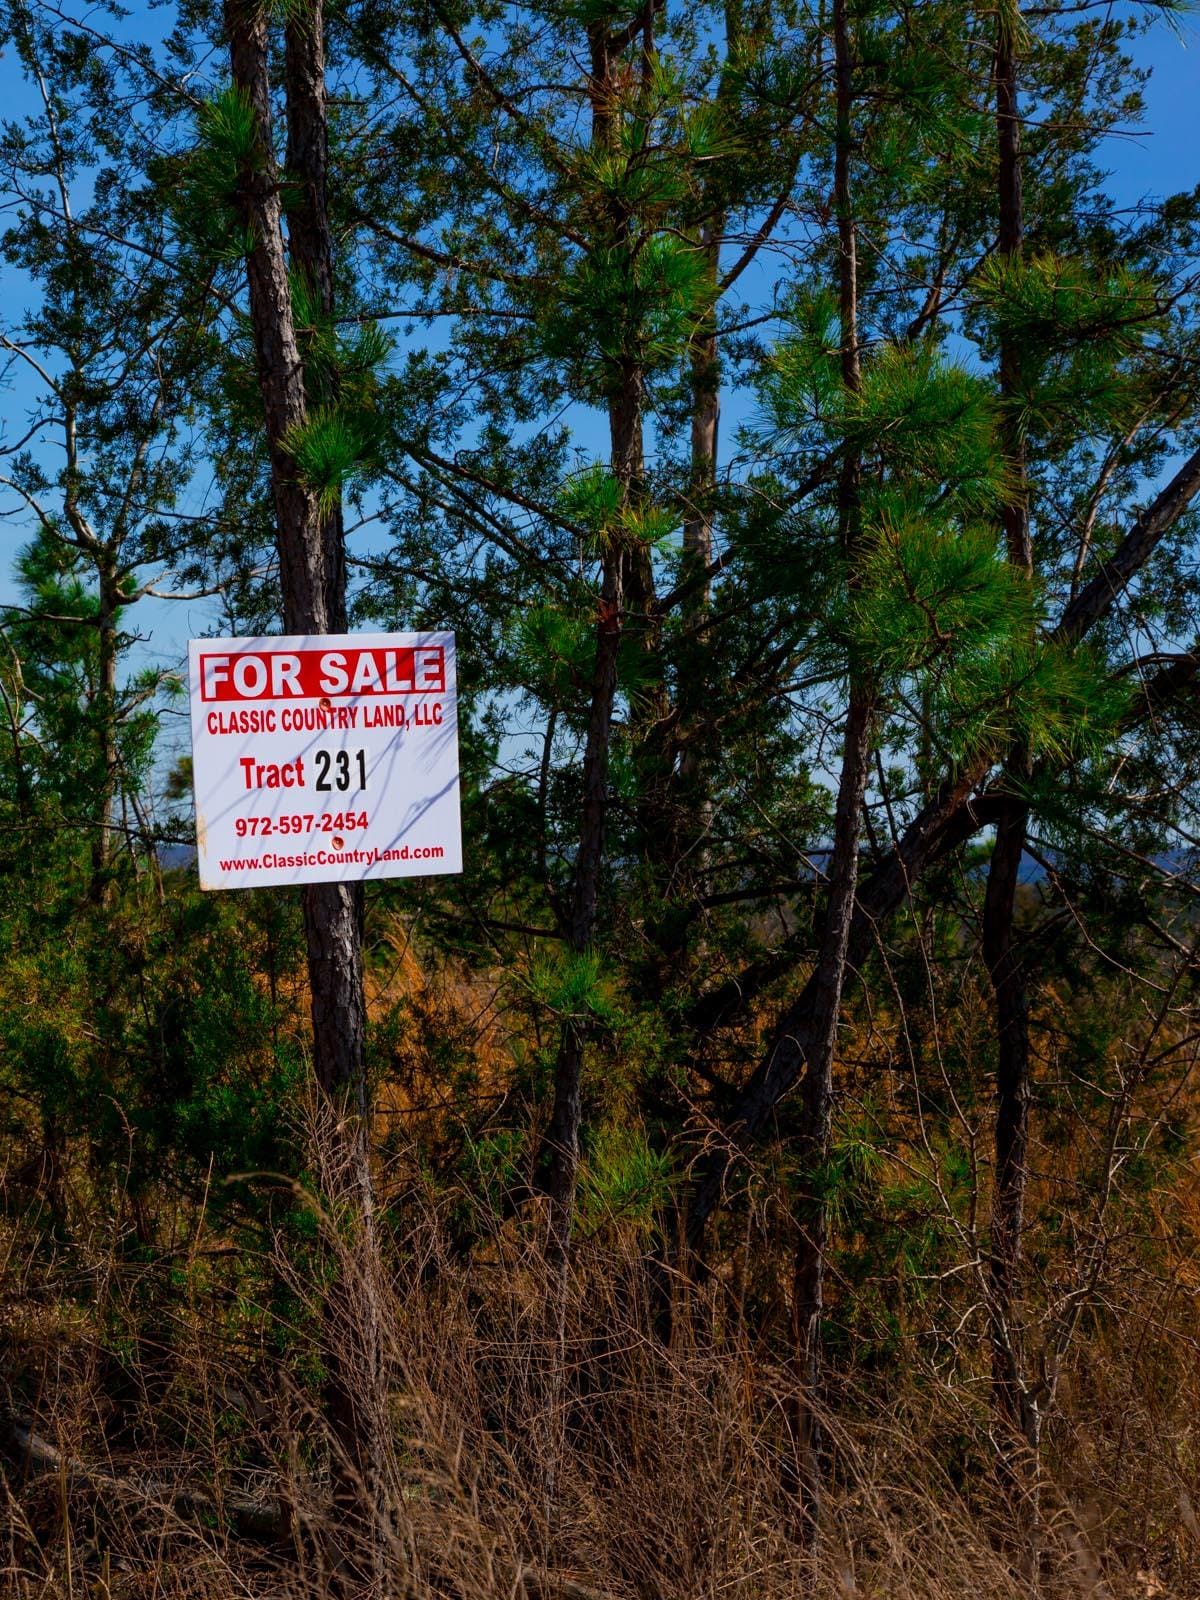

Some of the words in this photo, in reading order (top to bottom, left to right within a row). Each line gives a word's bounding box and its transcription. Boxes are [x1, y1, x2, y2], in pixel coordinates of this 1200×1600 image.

[203, 654, 303, 698] FOR
[319, 650, 442, 694] SALE
[207, 709, 276, 735] CLASSIC
[282, 706, 358, 731] COUNTRY
[364, 704, 410, 731] LAND,
[415, 703, 443, 725] LLC
[240, 755, 305, 789] Tract
[315, 749, 366, 791] 231
[235, 812, 368, 837] 972-597-2454
[220, 844, 444, 871] www.ClassicCountryLand.com
